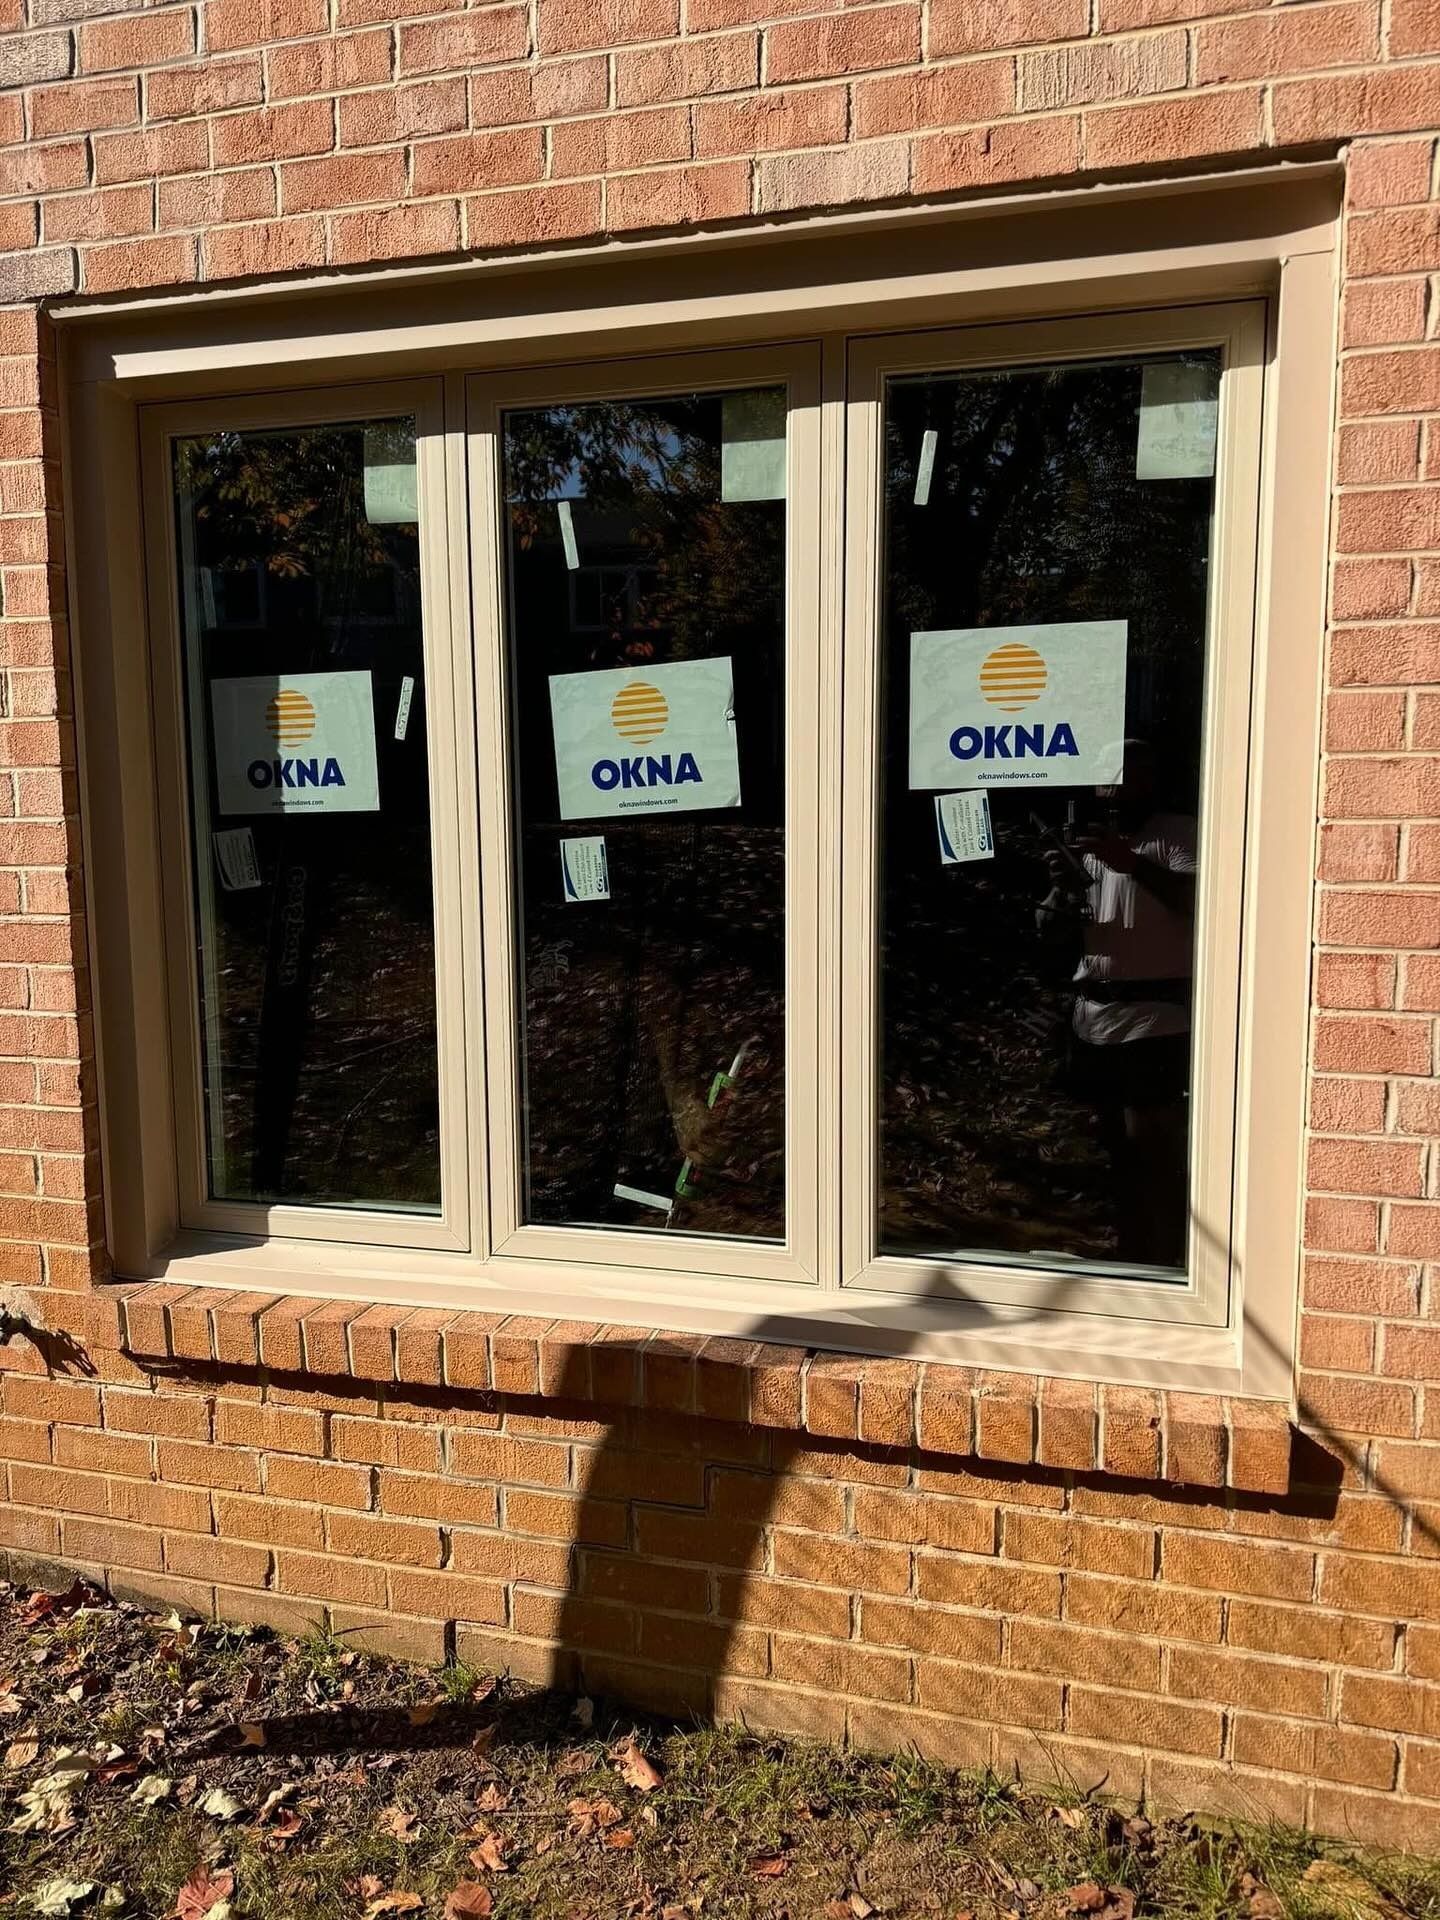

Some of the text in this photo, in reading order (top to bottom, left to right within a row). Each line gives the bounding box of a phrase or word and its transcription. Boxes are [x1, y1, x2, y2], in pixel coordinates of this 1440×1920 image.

[949, 723, 1079, 760] OKNA
[247, 757, 346, 790] OKNA
[591, 752, 703, 791] OKNA
[977, 771, 1049, 781] oknawindows.com
[618, 798, 679, 809] oknawindows.com
